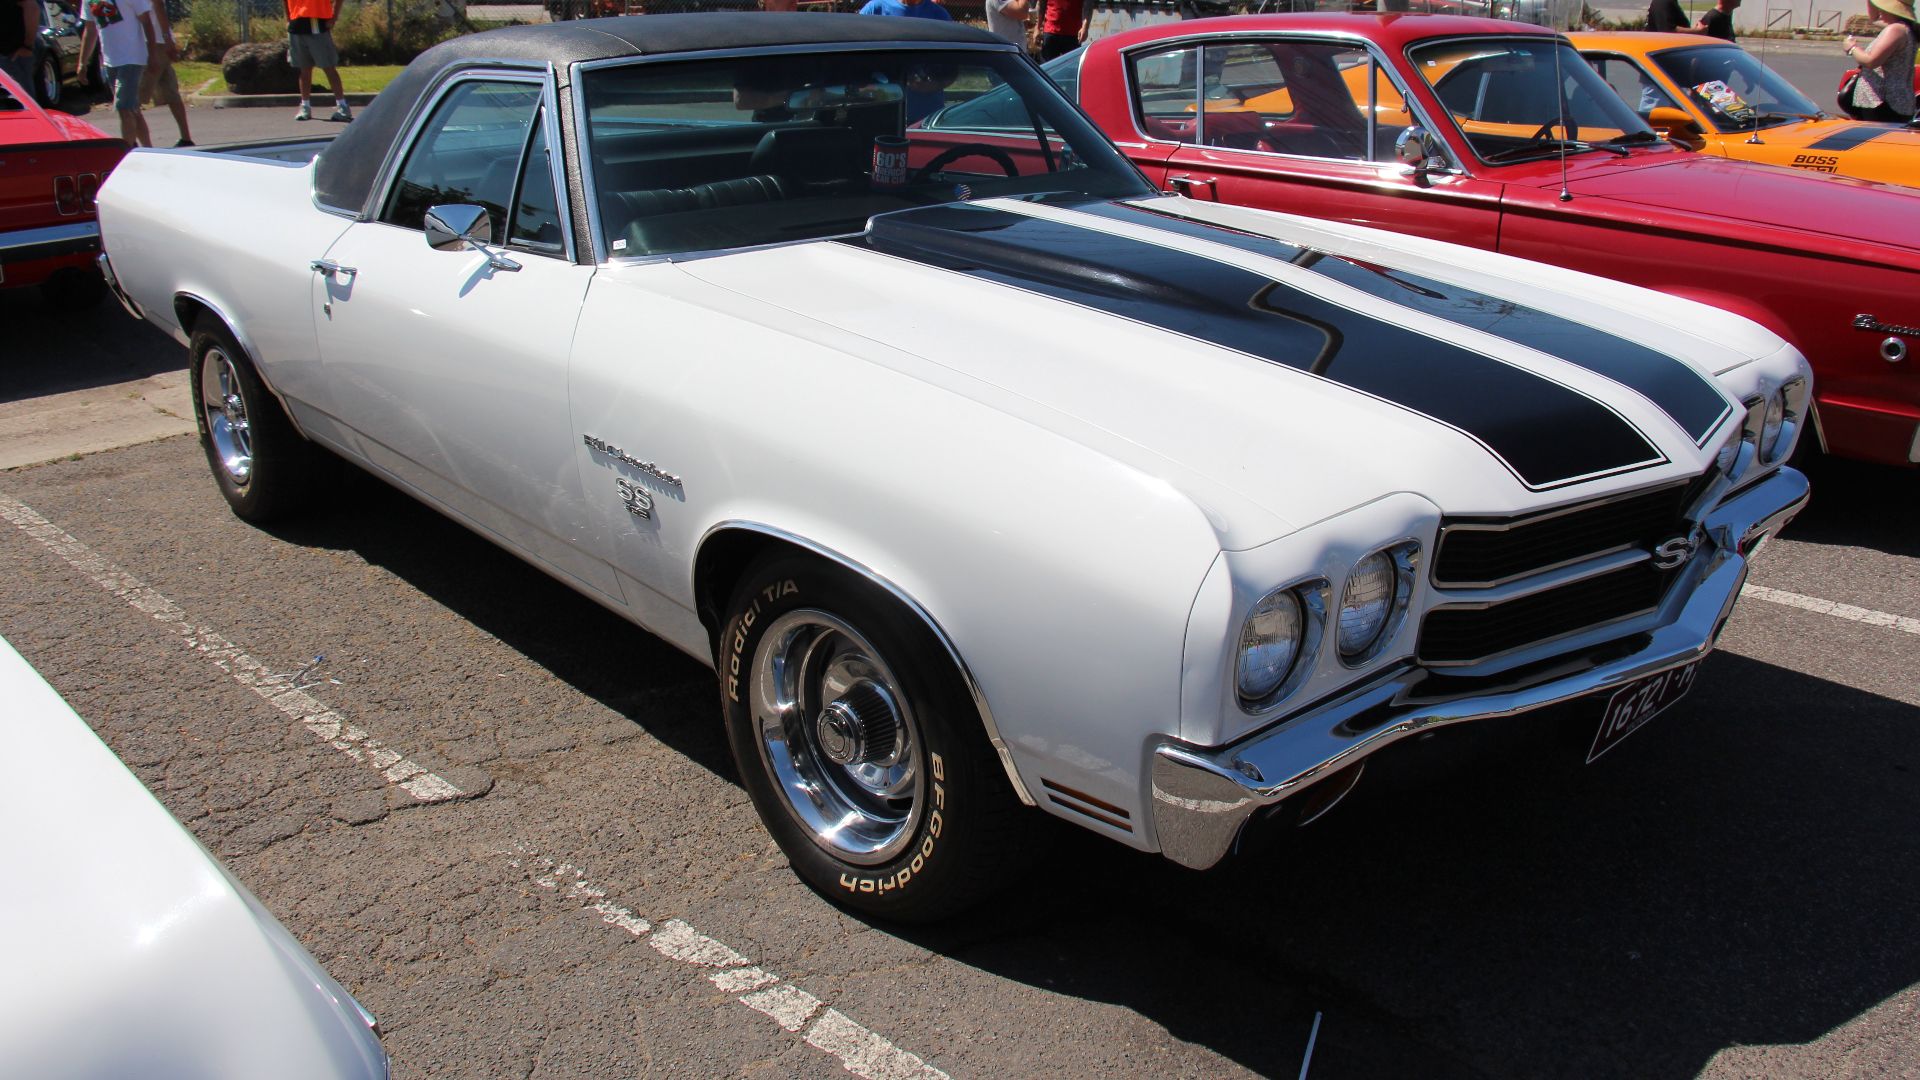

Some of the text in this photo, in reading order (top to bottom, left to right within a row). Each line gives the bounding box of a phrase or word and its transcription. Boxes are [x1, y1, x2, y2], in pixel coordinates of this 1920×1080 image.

[877, 151, 907, 167] 60'S
[1793, 154, 1839, 165] BOSS
[874, 165, 907, 177] AMERICA
[891, 176, 907, 185] CLU
[615, 477, 653, 511] SS
[729, 580, 799, 702] Radial T/A
[839, 751, 945, 896] BFGoodrich
